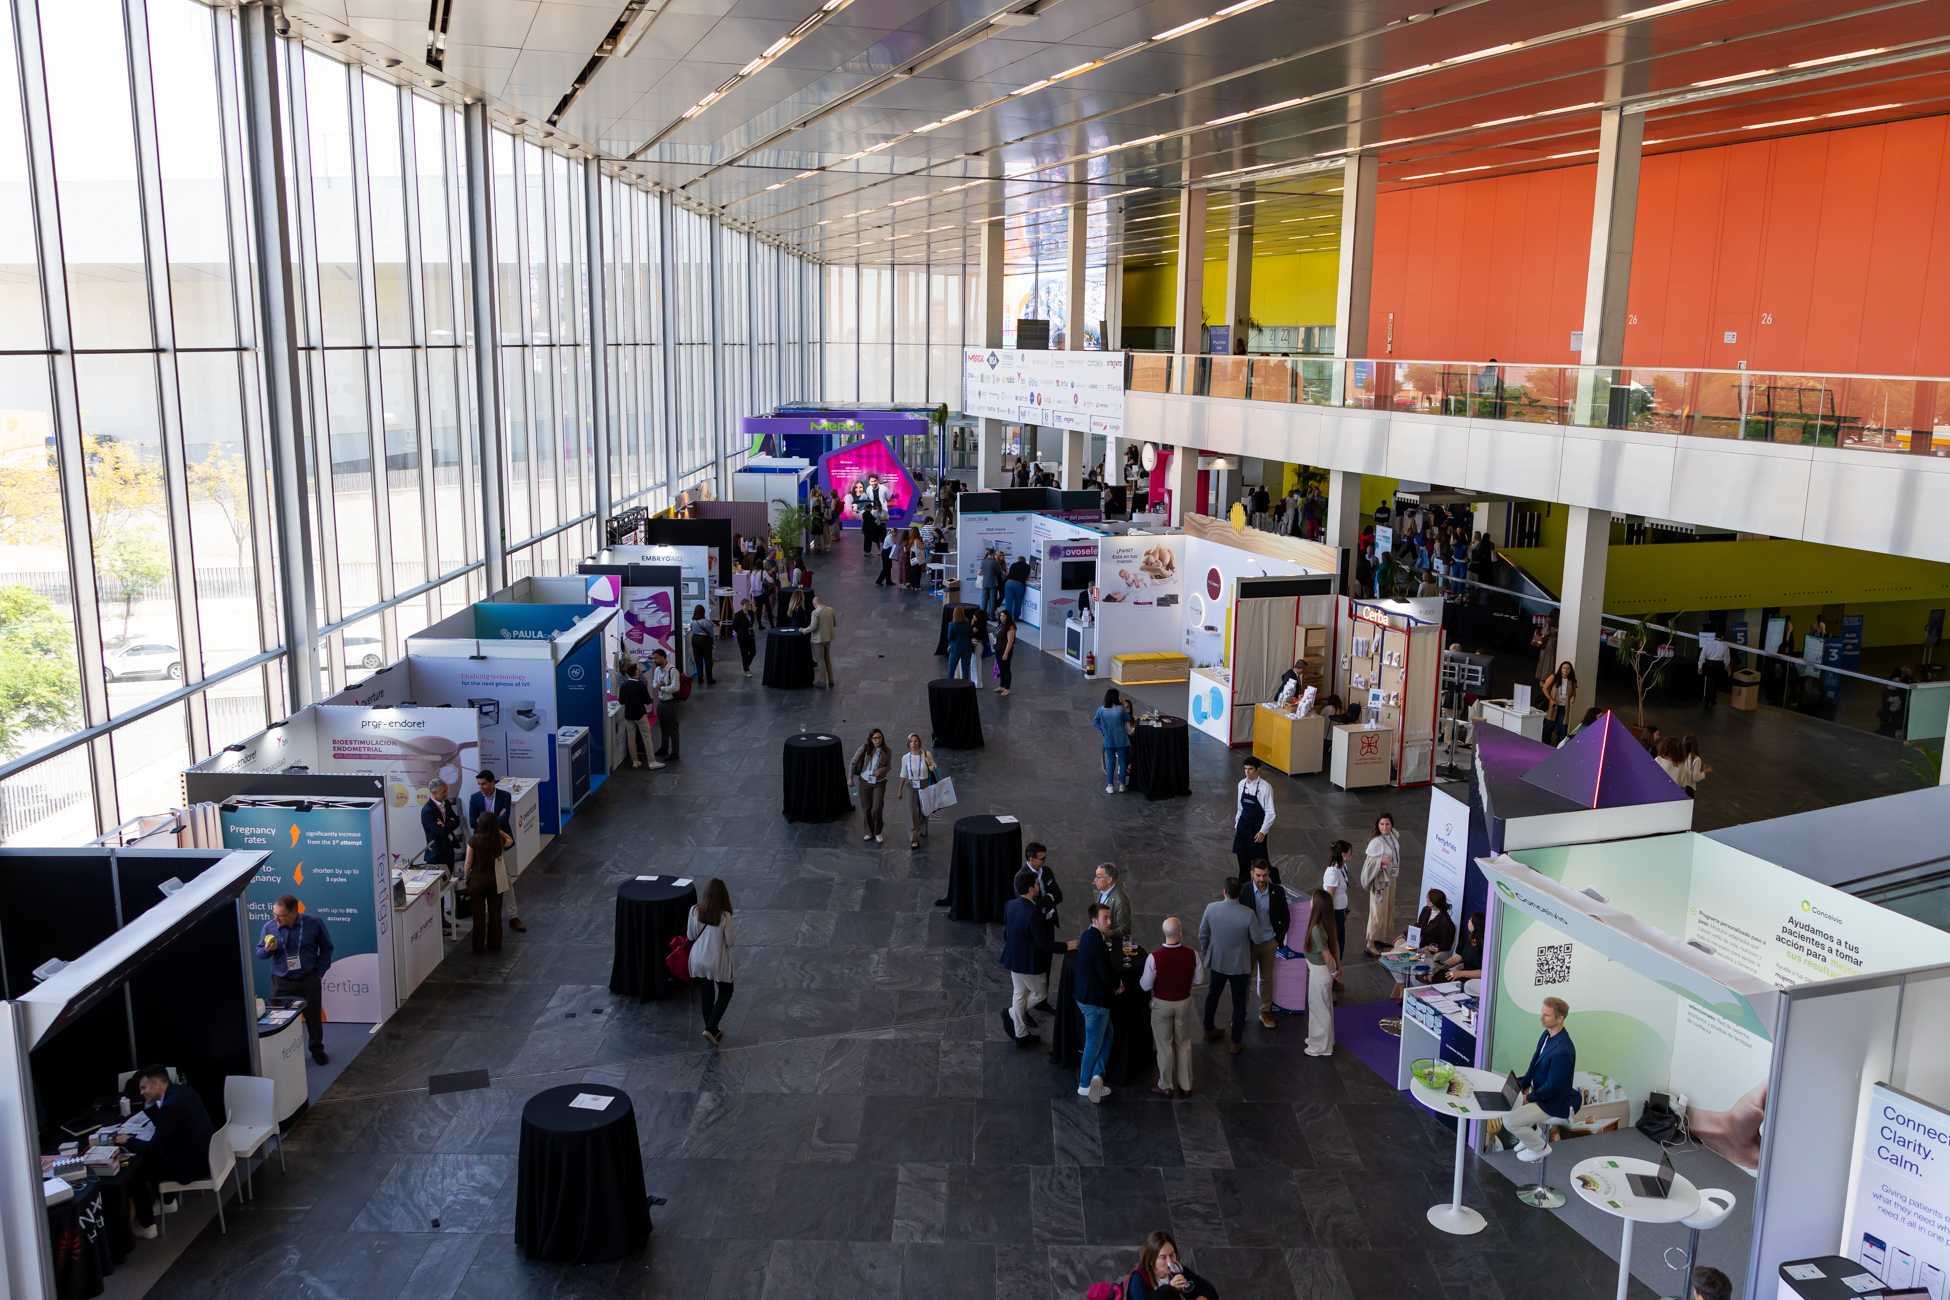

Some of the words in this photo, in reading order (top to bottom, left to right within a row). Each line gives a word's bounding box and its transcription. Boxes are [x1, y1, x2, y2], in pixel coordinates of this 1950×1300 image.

[1628, 314, 1638, 324] 26
[1762, 313, 1772, 324] 26
[1363, 606, 1389, 626] Cerba
[513, 630, 543, 638] PAULA
[1737, 632, 1745, 644] 5
[1828, 648, 1838, 661] 3
[230, 825, 276, 836] Pregnancy
[377, 853, 389, 935] fertiga
[1699, 910, 1719, 924] Programa
[1720, 922, 1750, 938] personalizado
[1812, 906, 1842, 924] Conceivio
[1698, 927, 1711, 936] cubren
[1712, 932, 1722, 941] estilo
[1788, 916, 1834, 943] Ayudamos
[1844, 941, 1860, 954] tus
[1711, 941, 1730, 952] necesario
[1741, 956, 1755, 965] apoyar
[1776, 935, 1804, 953] acción
[1806, 949, 1826, 963] para
[1782, 926, 1825, 950] pacientes
[1835, 949, 1863, 967] tomar
[1786, 950, 1802, 963] sus
[1775, 962, 1791, 973] Ayuda
[323, 979, 369, 996] fertiga
[1775, 972, 1795, 985] mujeres
[1688, 1011, 1707, 1024] productos
[1711, 1024, 1727, 1035] pruebas
[1693, 1022, 1711, 1034] confianza
[1880, 1126, 1934, 1161] Clarity.
[1877, 1146, 1922, 1177] Calm.
[1873, 1192, 1892, 1206] what
[1894, 1202, 1912, 1216] they
[1913, 1212, 1935, 1226] need
[1882, 1184, 1907, 1203] Giving
[1909, 1198, 1942, 1219] patients
[1878, 1206, 1899, 1220] need
[1900, 1215, 1905, 1224] it
[1907, 1220, 1916, 1229] all
[1918, 1224, 1926, 1234] in
[1928, 1230, 1944, 1242] one
